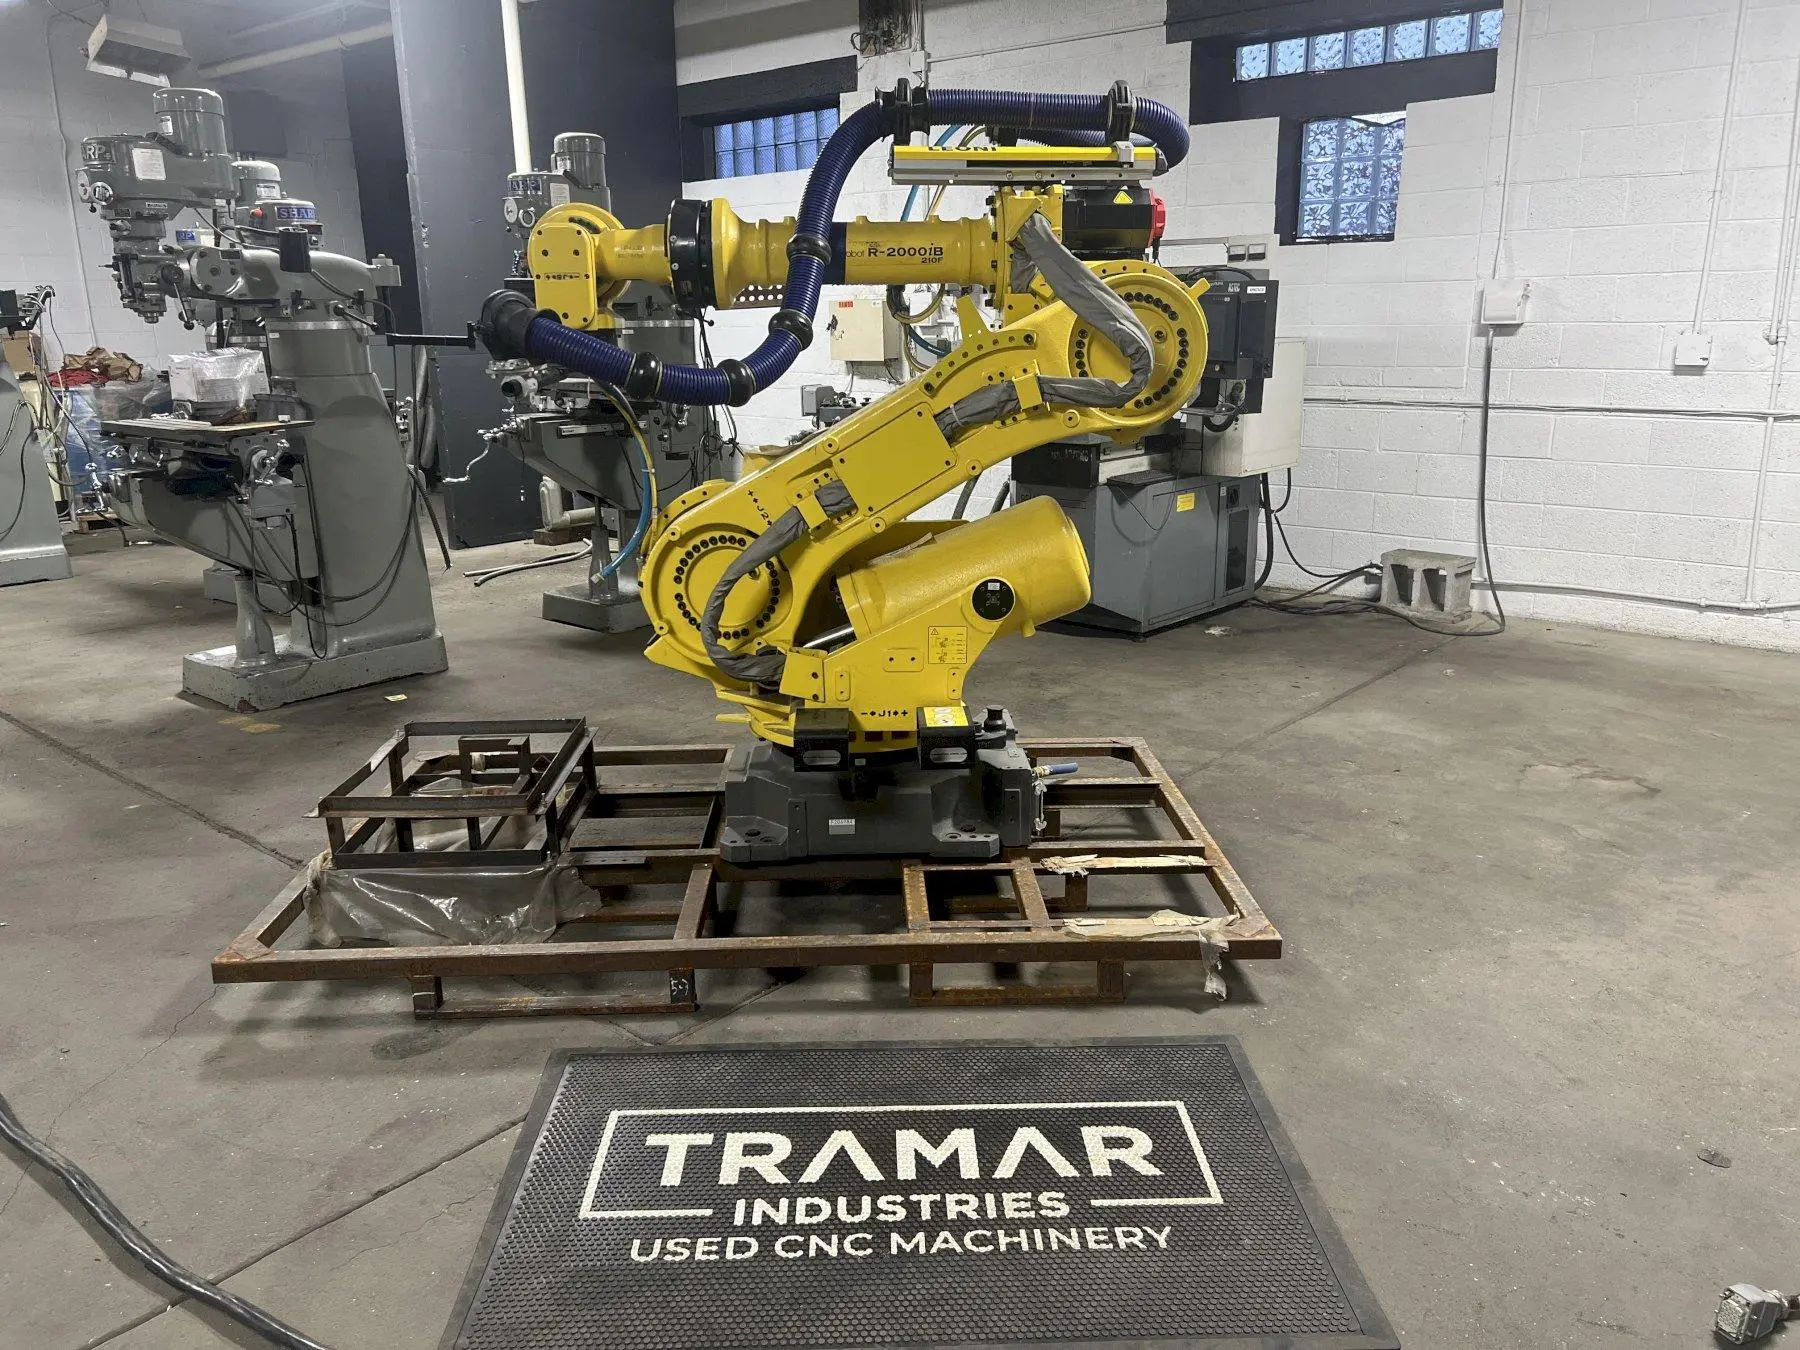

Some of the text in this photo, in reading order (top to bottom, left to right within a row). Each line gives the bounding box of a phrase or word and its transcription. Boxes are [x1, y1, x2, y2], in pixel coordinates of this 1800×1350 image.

[868, 243, 944, 257] R-2000iB
[644, 1125, 1165, 1187] TRAMAR
[733, 1191, 1071, 1236] INDUSTRIES
[630, 1225, 1173, 1263] USED CNC MACHINERY
